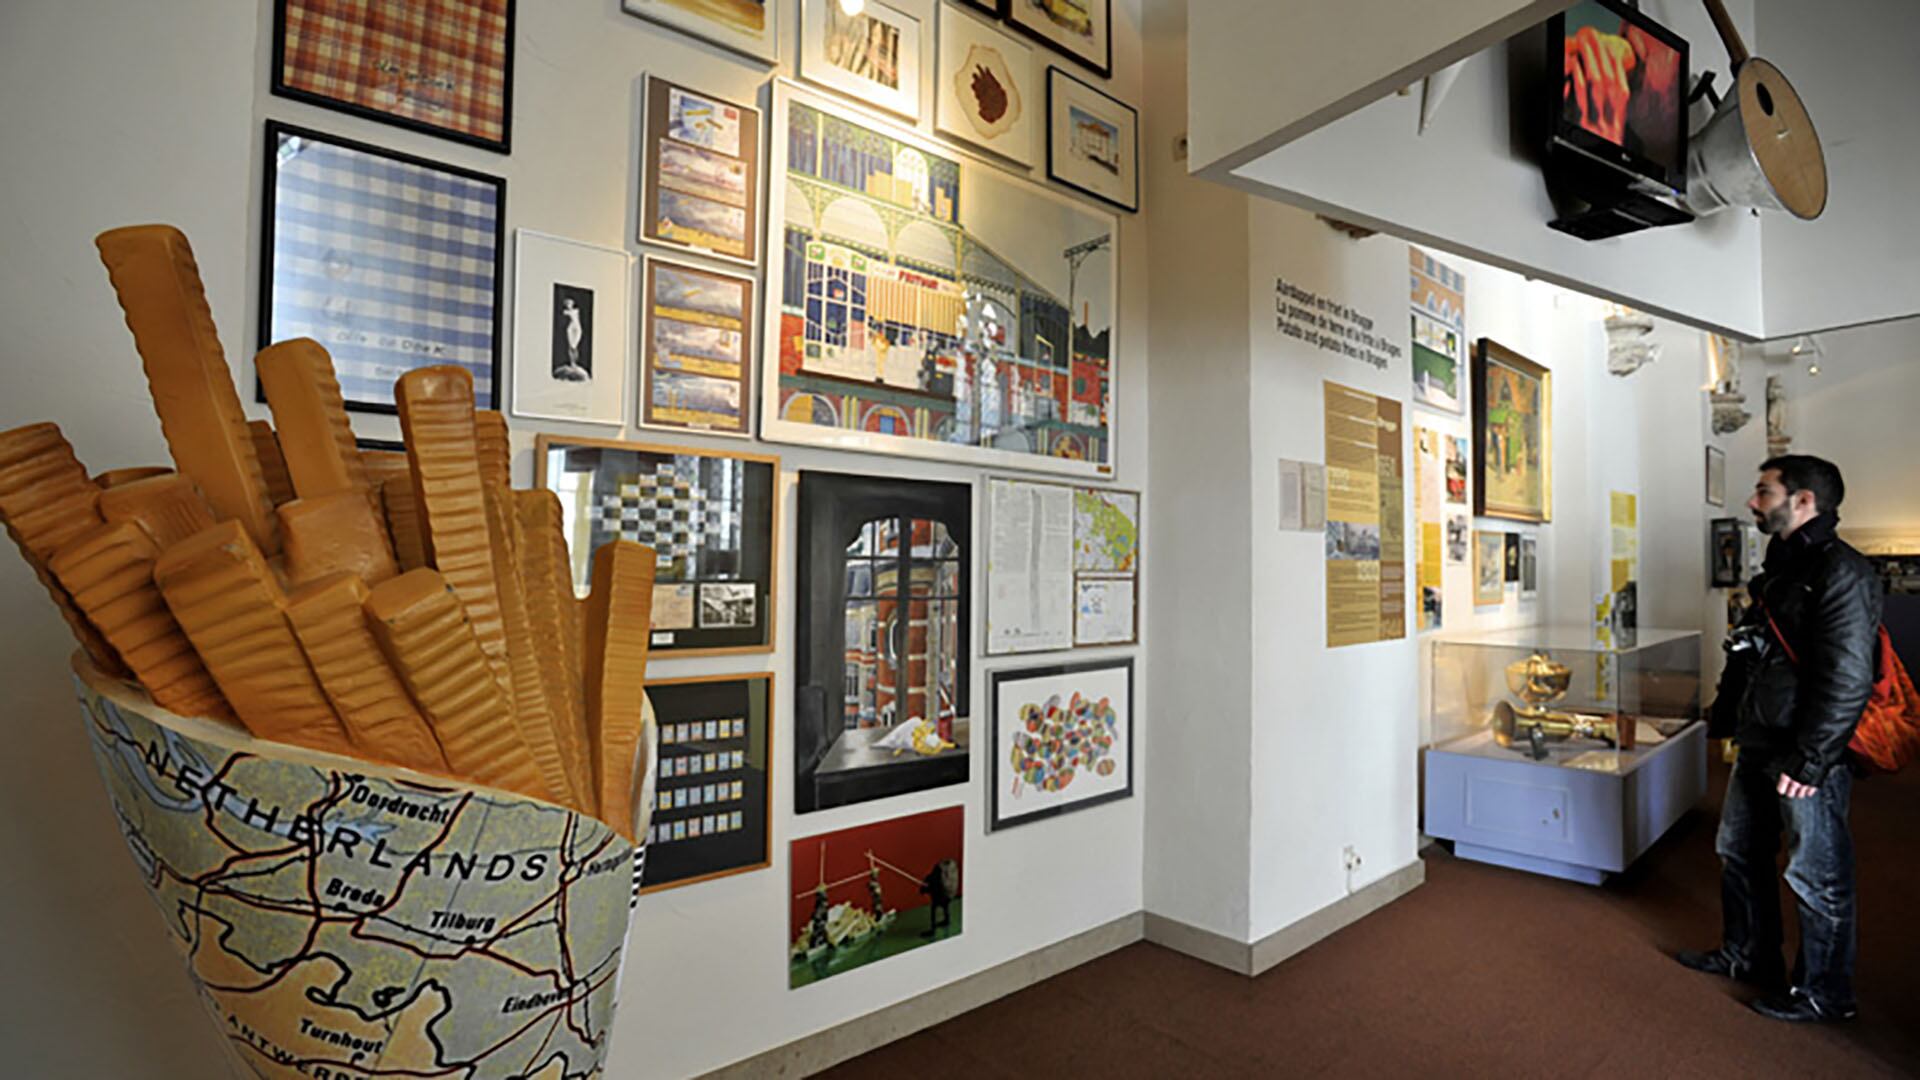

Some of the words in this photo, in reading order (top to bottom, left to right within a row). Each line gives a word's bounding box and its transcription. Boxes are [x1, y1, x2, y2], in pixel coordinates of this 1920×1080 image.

[146, 740, 548, 883] NETHERLANDS
[351, 784, 450, 825] Dordrecht
[325, 878, 386, 907] Breda
[430, 910, 497, 933] Tilburg
[299, 1017, 384, 1054] Turnhout
